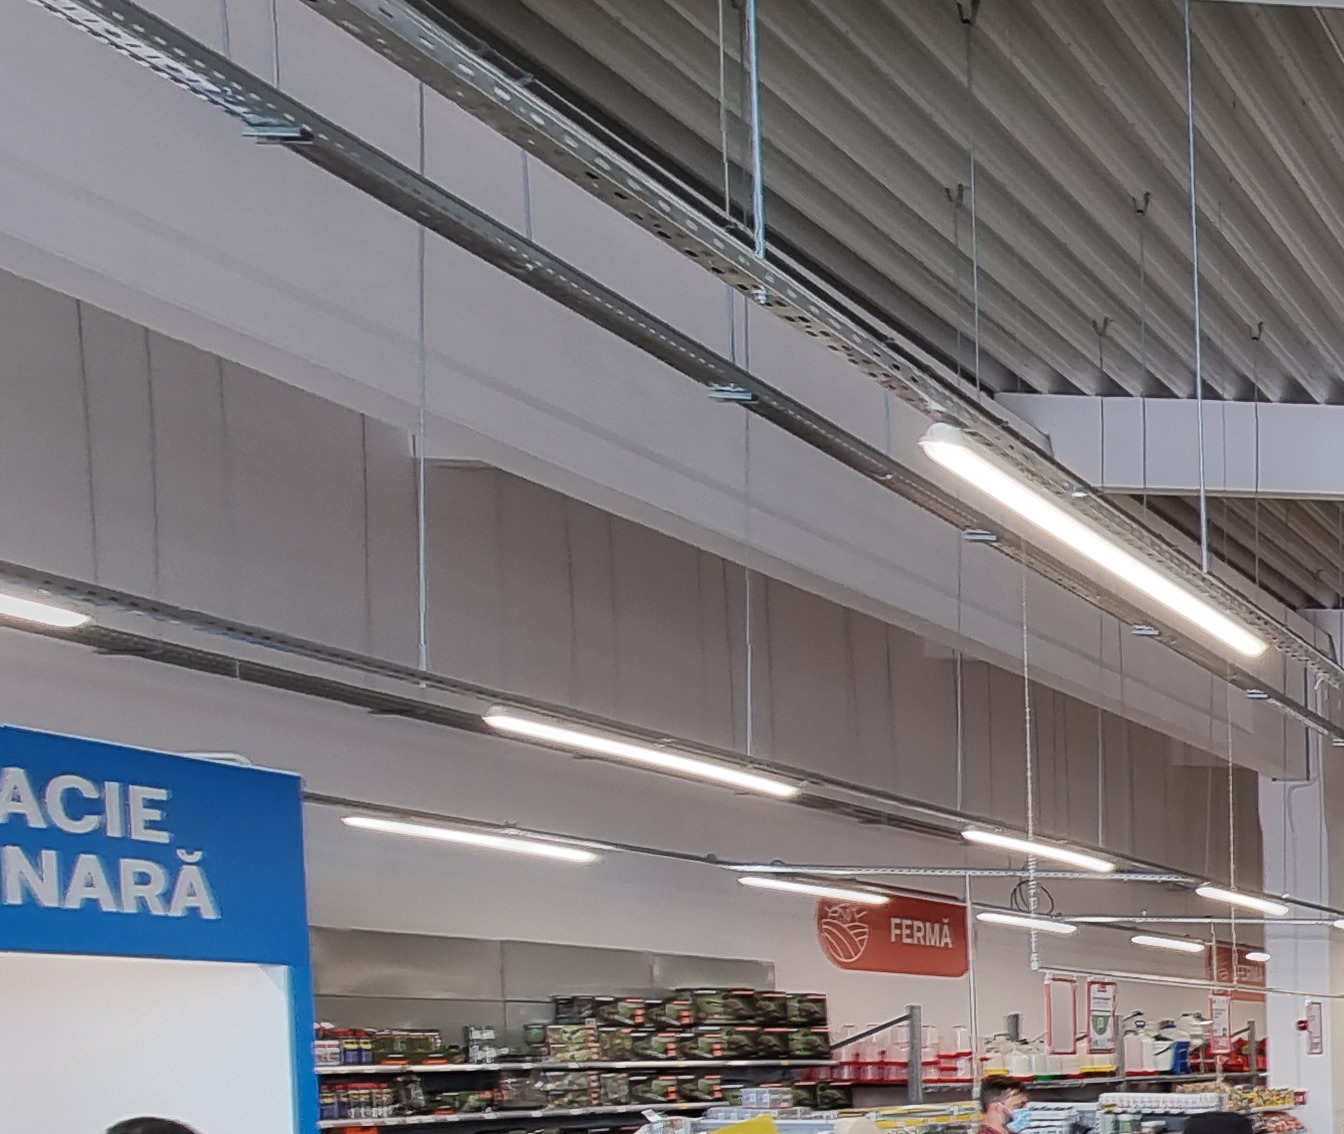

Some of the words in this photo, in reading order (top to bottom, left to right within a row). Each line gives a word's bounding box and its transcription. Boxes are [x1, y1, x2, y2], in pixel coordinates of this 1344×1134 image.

[0, 766, 172, 844] ACIE
[2, 846, 221, 920] NARĂ
[890, 917, 953, 949] FERMĂ
